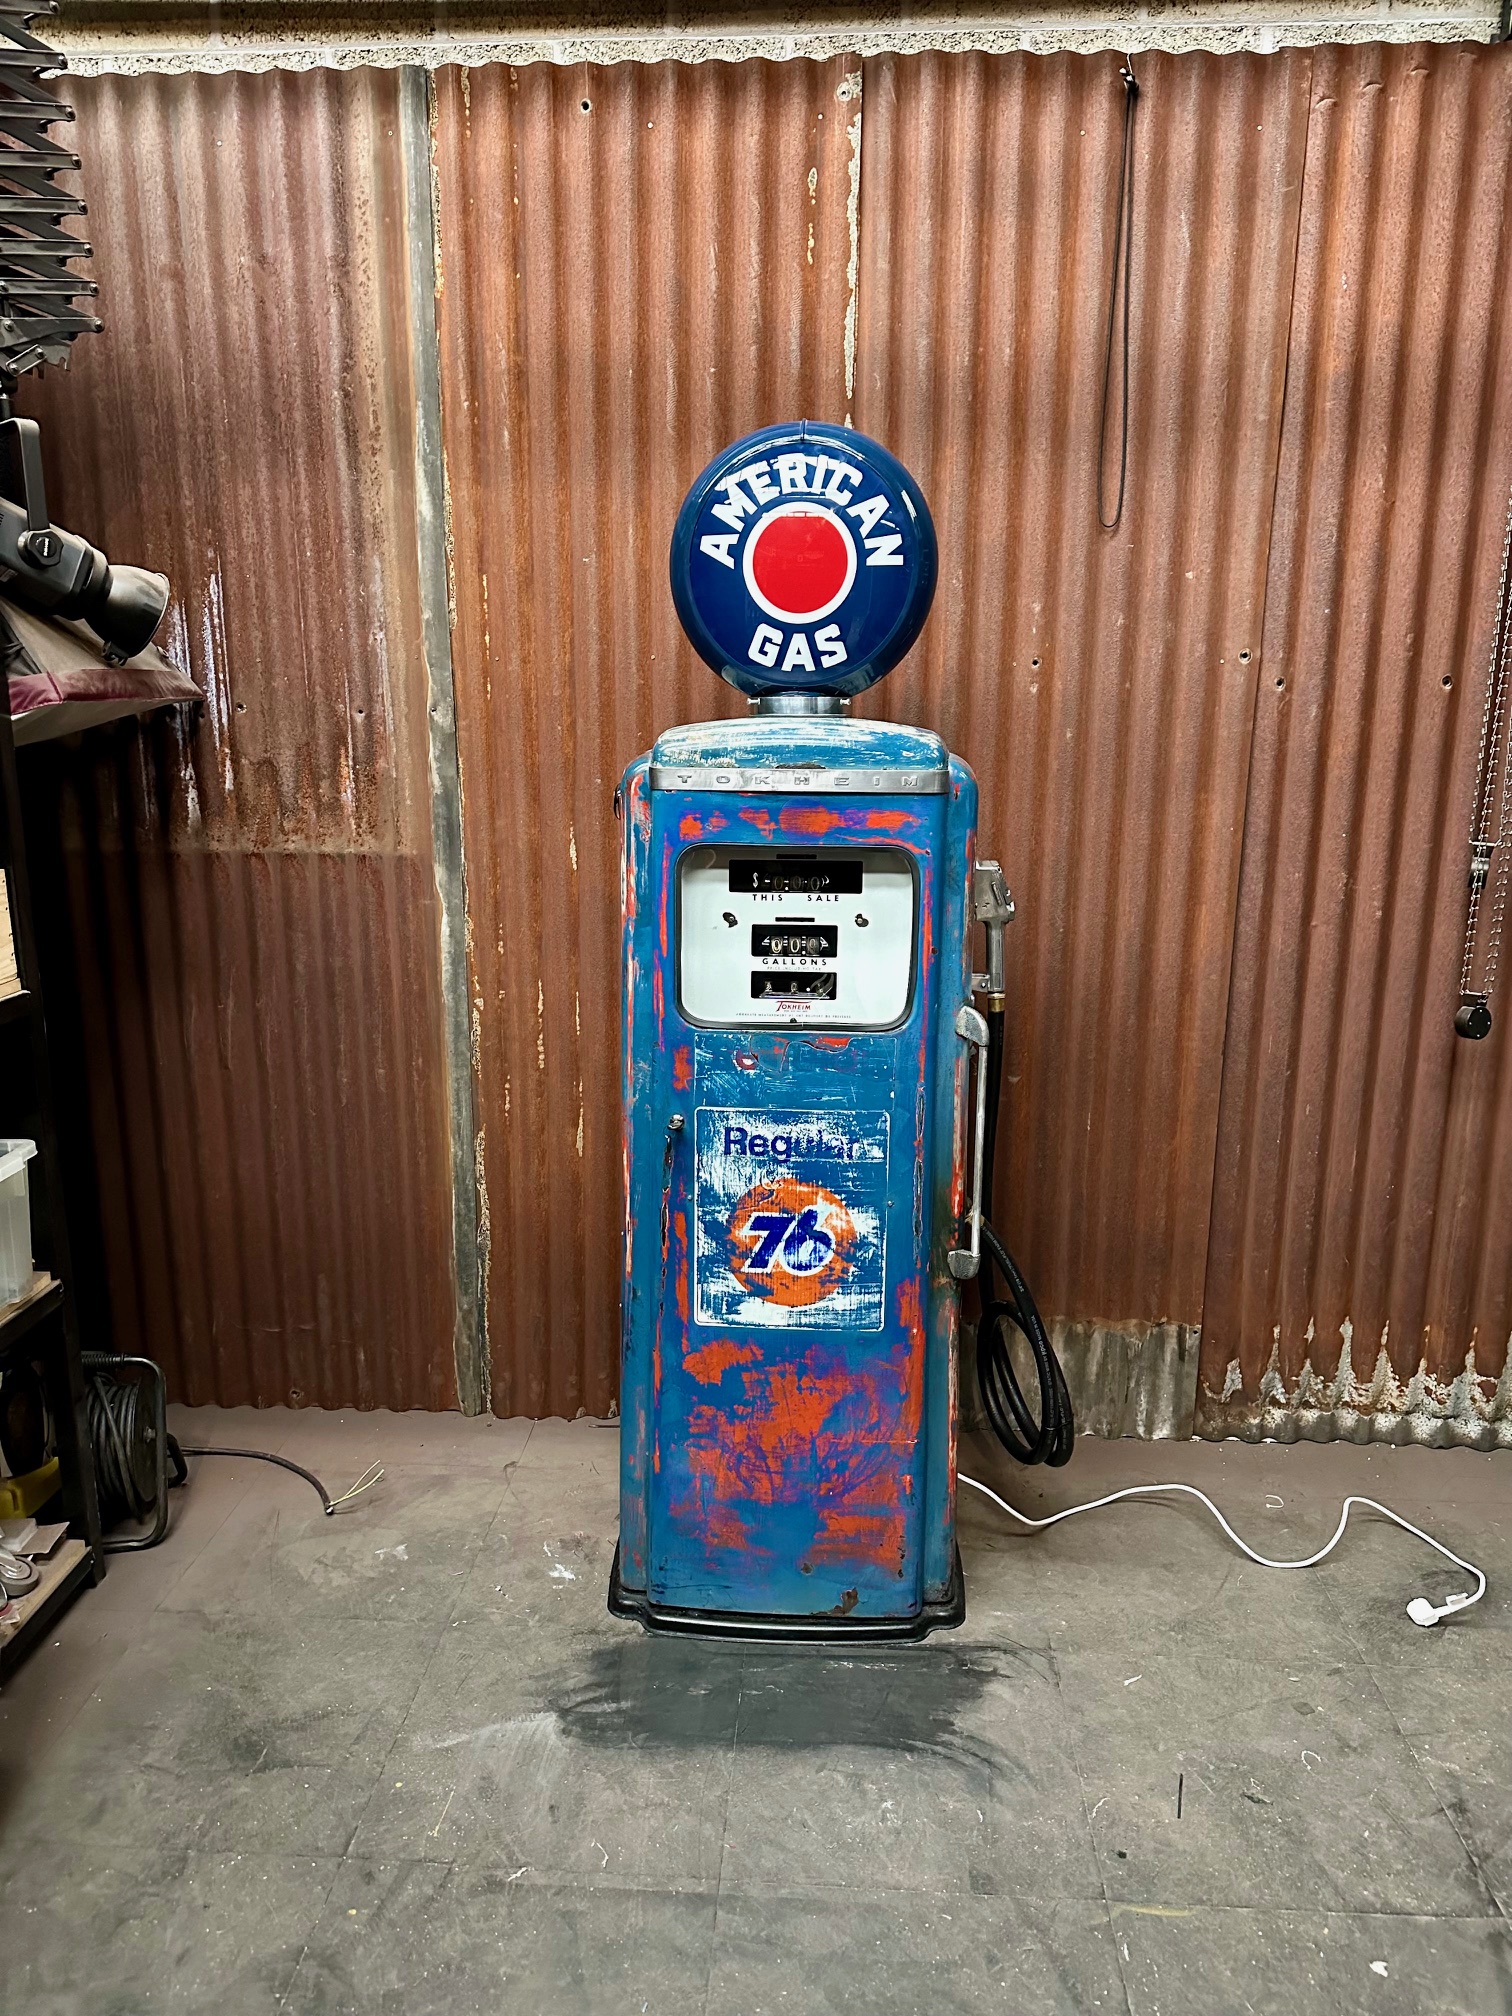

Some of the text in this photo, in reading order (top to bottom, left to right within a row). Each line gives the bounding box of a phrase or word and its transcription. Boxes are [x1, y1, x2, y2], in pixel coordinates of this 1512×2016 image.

[700, 453, 904, 570] AMERICAN
[748, 623, 848, 672] GAS
[677, 775, 919, 787] TOKHEIM
[752, 893, 839, 902] THIS SALE
[762, 957, 827, 966] GALLONS
[744, 1206, 835, 1274] 76
